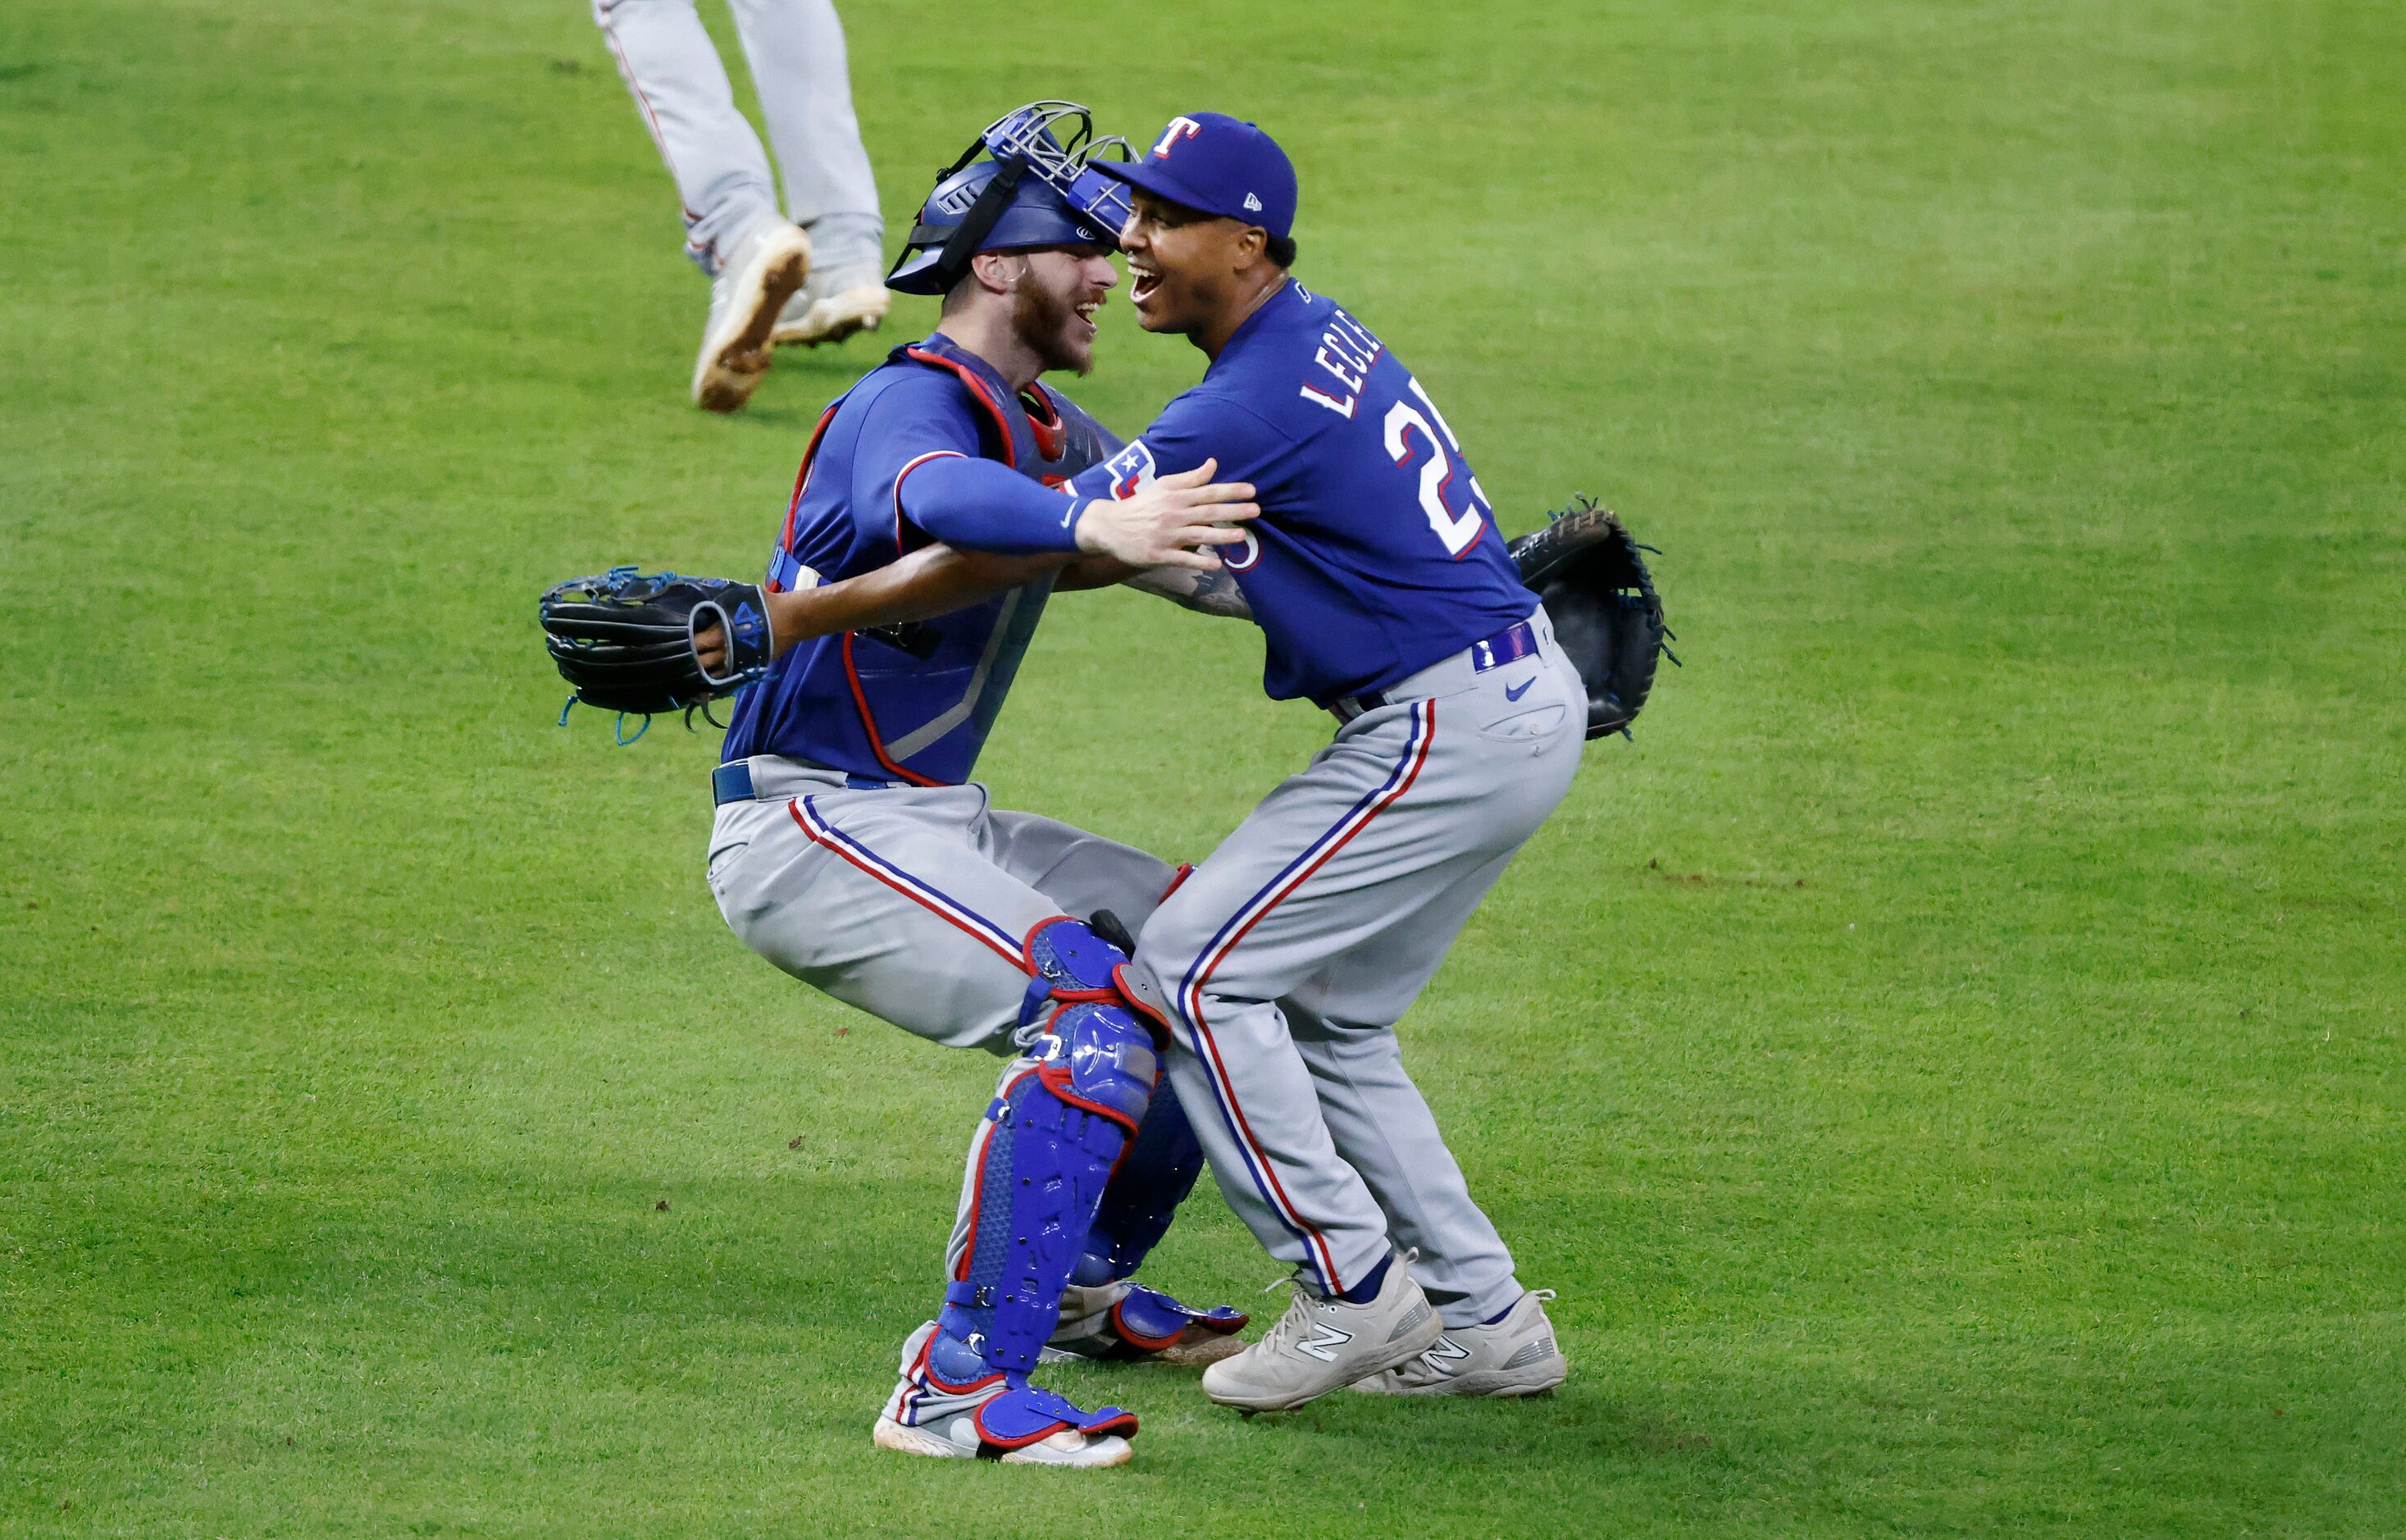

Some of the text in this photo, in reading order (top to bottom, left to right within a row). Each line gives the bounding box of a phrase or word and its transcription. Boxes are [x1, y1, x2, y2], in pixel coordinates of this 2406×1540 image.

[1153, 116, 1201, 159] T
[1300, 309, 1385, 420] LECLE
[1295, 1321, 1356, 1363] N
